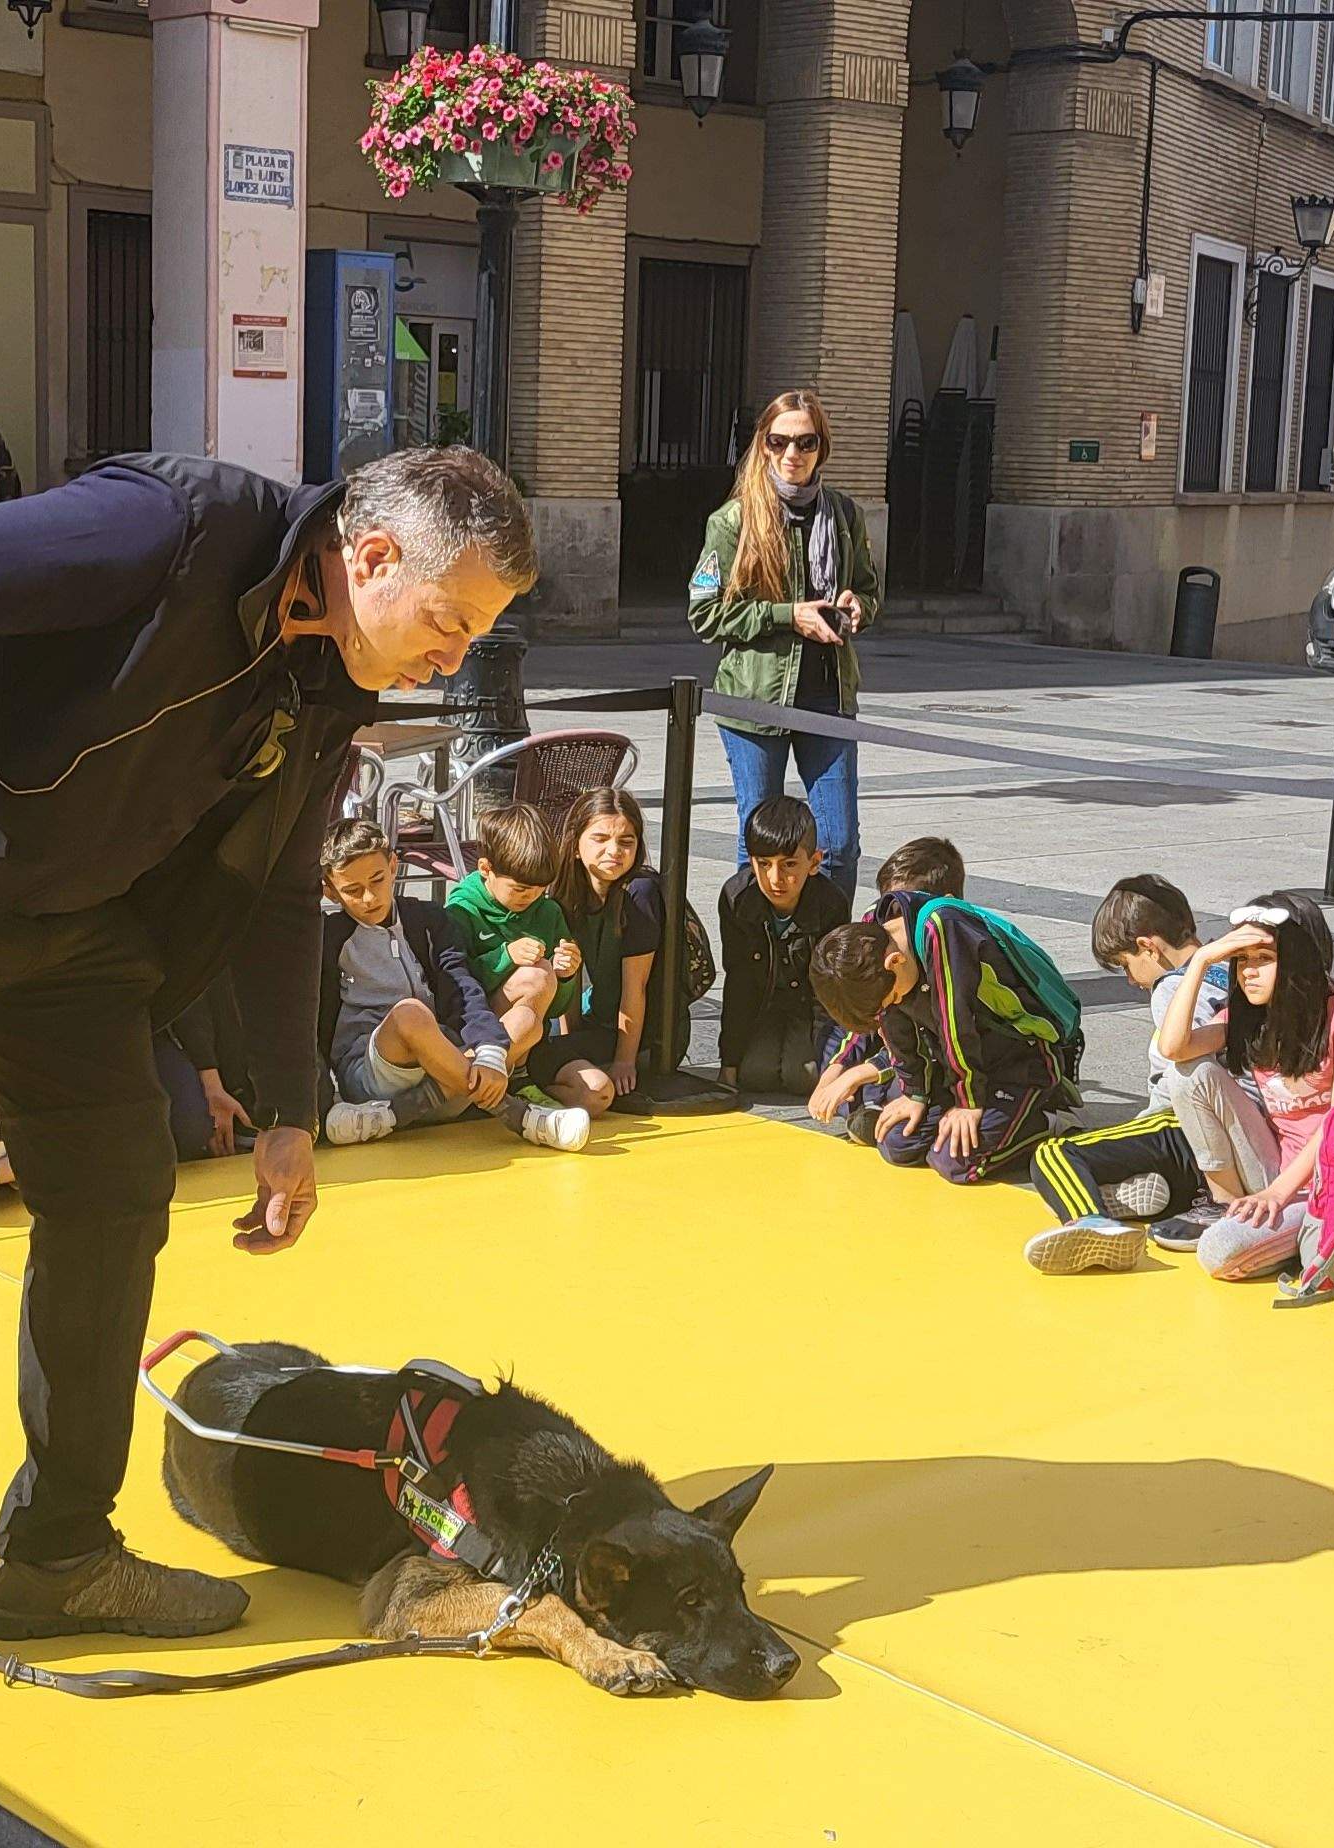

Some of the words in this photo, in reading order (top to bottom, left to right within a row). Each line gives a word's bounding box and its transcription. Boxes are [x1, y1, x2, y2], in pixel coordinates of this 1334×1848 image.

[245, 154, 275, 168] PLAZA
[277, 159, 289, 169] DE
[258, 170, 285, 183] LUIS
[430, 1513, 454, 1538] ONCE
